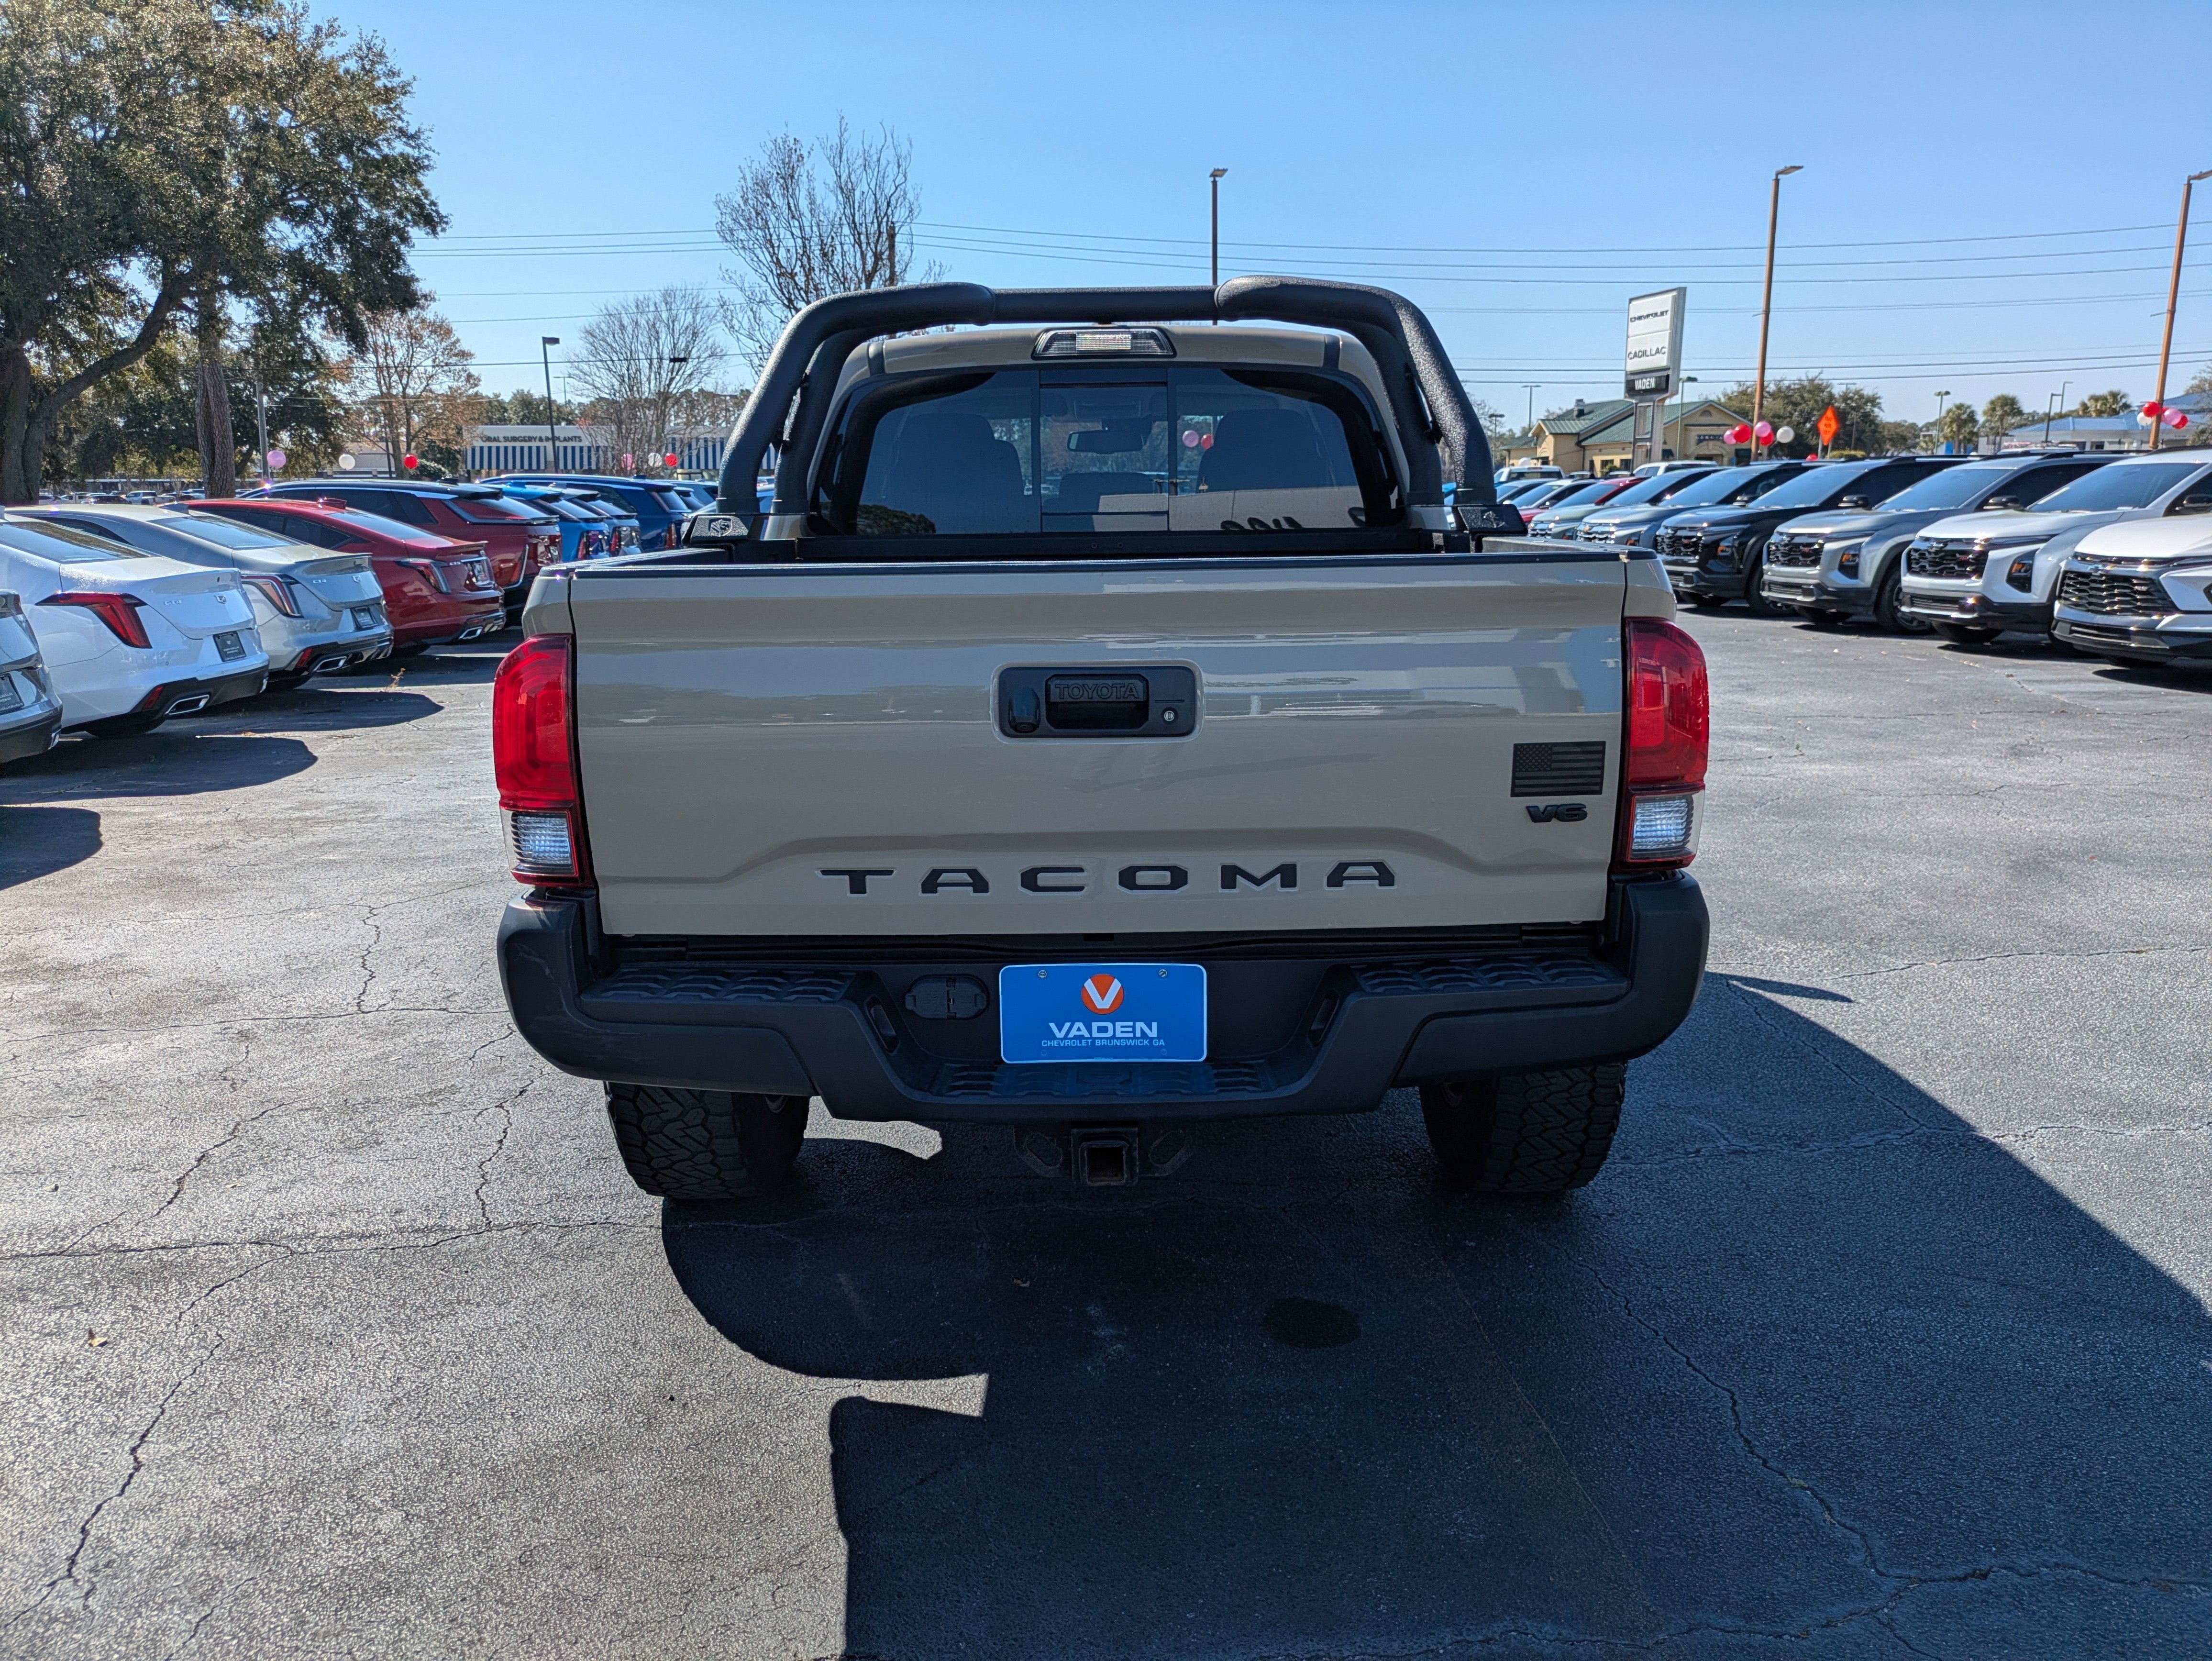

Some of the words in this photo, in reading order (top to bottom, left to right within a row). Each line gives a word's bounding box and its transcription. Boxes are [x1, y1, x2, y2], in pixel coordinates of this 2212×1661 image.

[1627, 346, 1666, 360] CADILLAC
[1635, 377, 1656, 390] VADEN
[1055, 683, 1139, 699] TOYOTA
[1526, 803, 1588, 823] V6
[818, 861, 1396, 895] TACOMA
[1084, 978, 1122, 1009] V
[1048, 1021, 1158, 1038] VADEN
